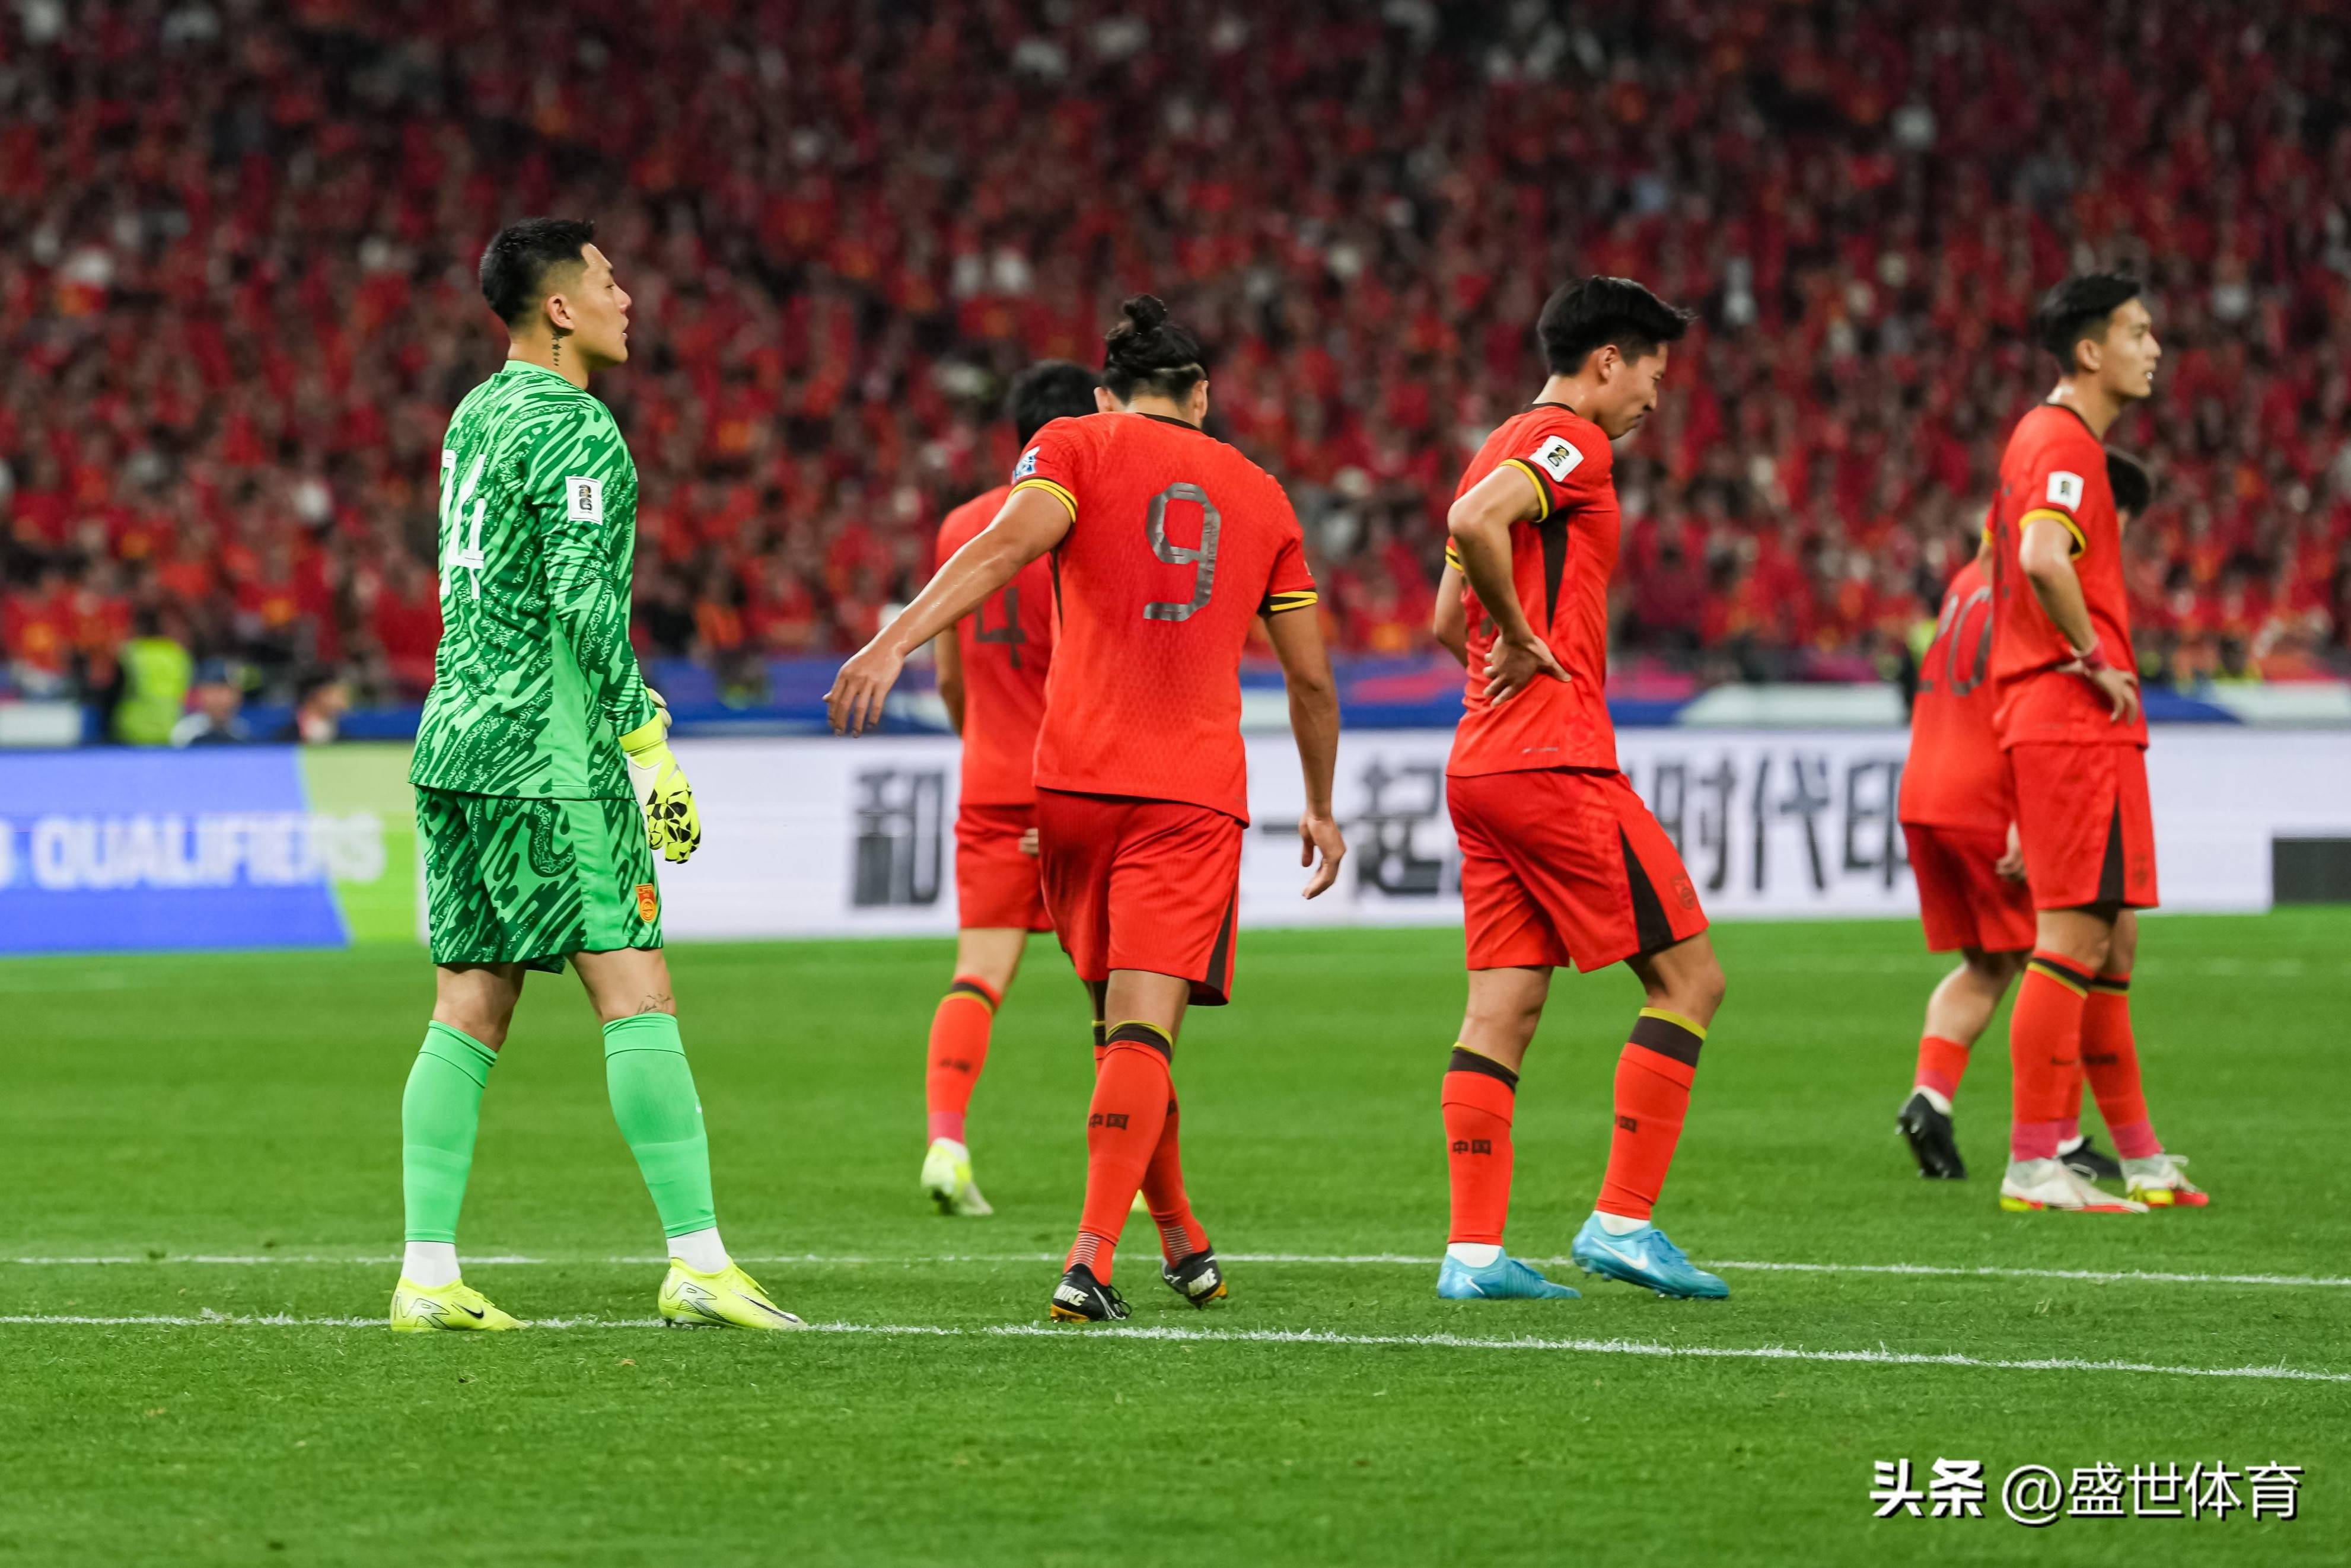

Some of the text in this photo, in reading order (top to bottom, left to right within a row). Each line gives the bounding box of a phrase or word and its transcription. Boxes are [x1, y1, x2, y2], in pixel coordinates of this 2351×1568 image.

[1143, 482, 1221, 622] 9
[976, 586, 1026, 669] 4
[32, 810, 387, 891] QUALIFIERS
[1452, 1139, 1492, 1155] 中国
